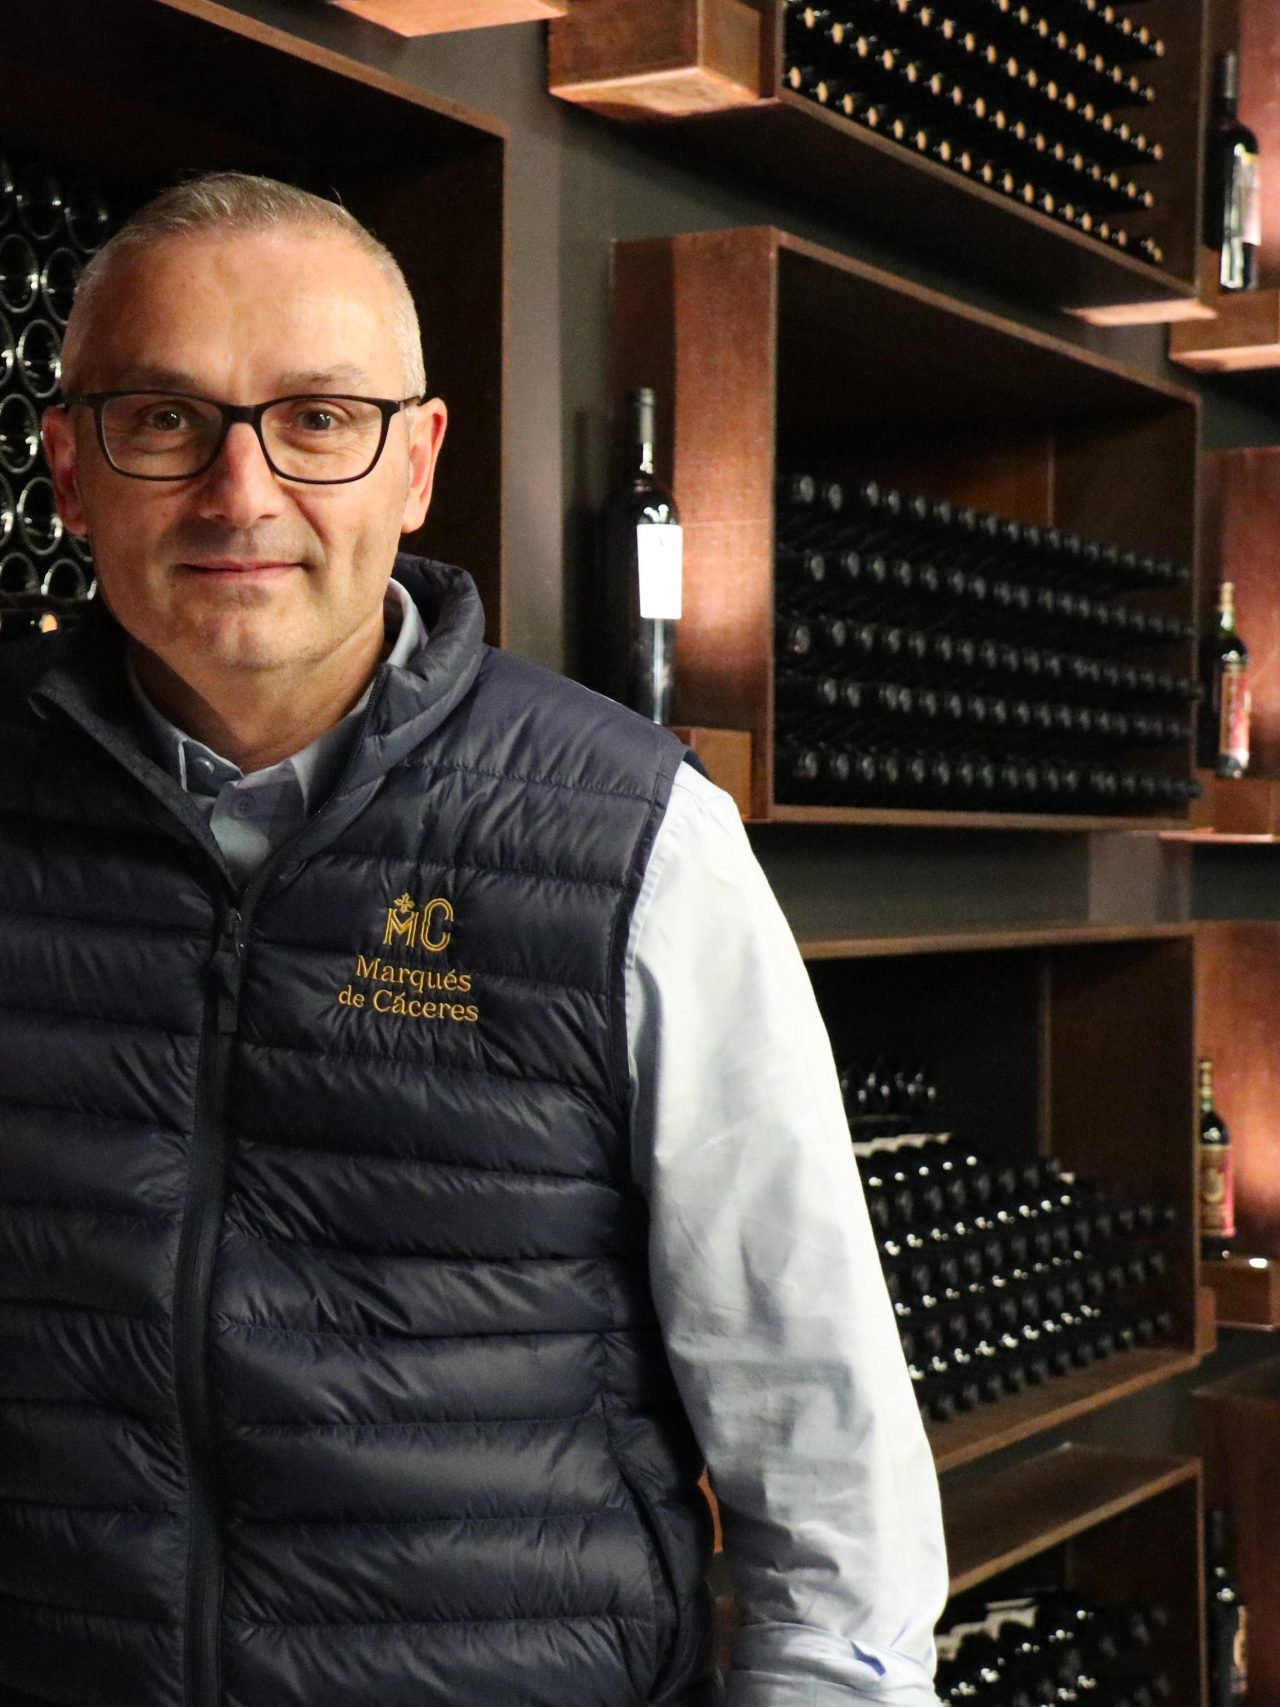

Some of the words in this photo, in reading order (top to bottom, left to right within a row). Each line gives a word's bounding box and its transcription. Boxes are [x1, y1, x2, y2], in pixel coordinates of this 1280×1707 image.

[383, 897, 454, 952] MC
[356, 955, 472, 993] Marqués
[338, 985, 365, 1008] de
[373, 989, 479, 1022] Cáceres
